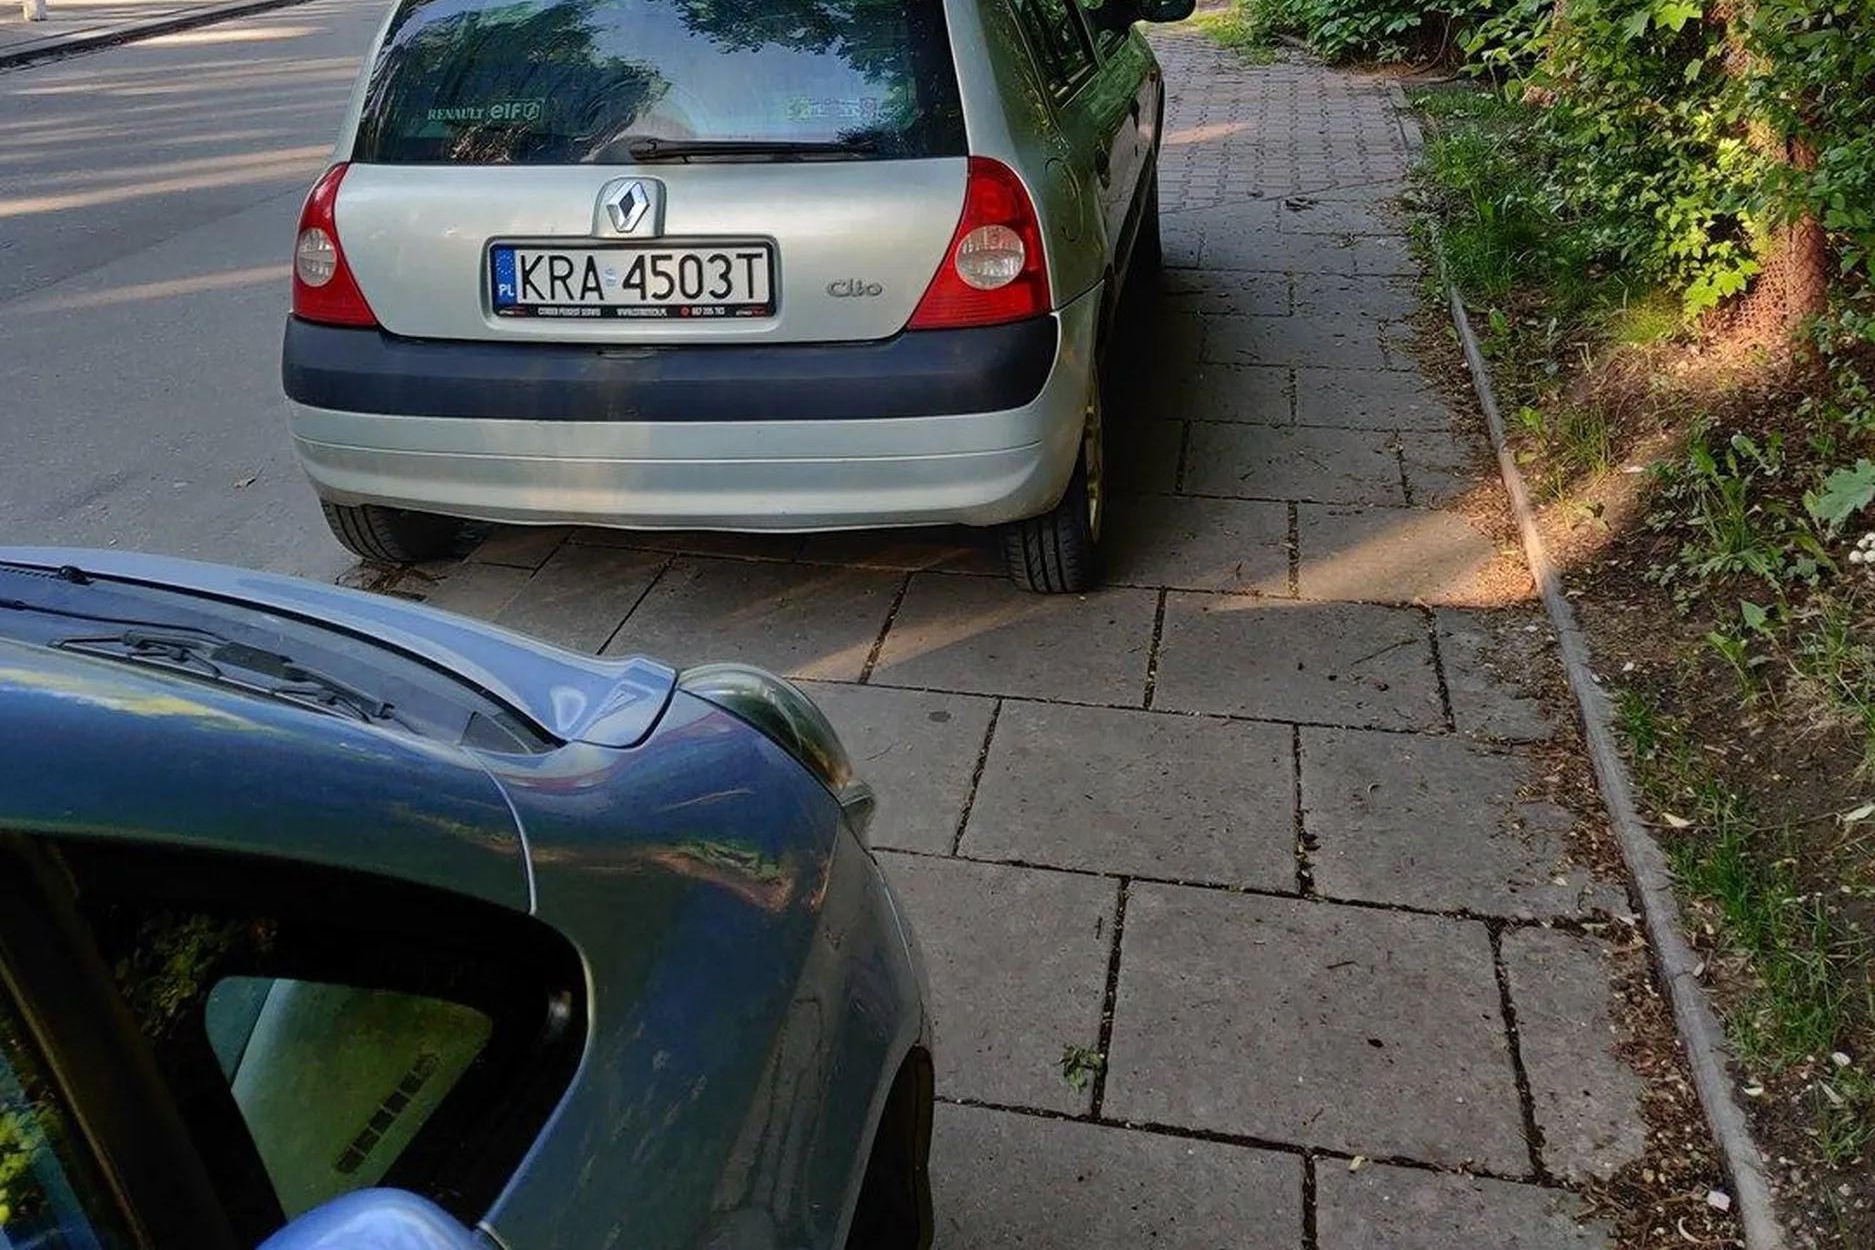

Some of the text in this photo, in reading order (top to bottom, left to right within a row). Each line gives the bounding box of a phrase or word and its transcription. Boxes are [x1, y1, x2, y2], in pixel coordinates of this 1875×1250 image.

[427, 102, 522, 120] RENAULT elf
[519, 252, 764, 301] KRA 4503T
[499, 284, 514, 296] PL
[826, 278, 883, 297] Clio
